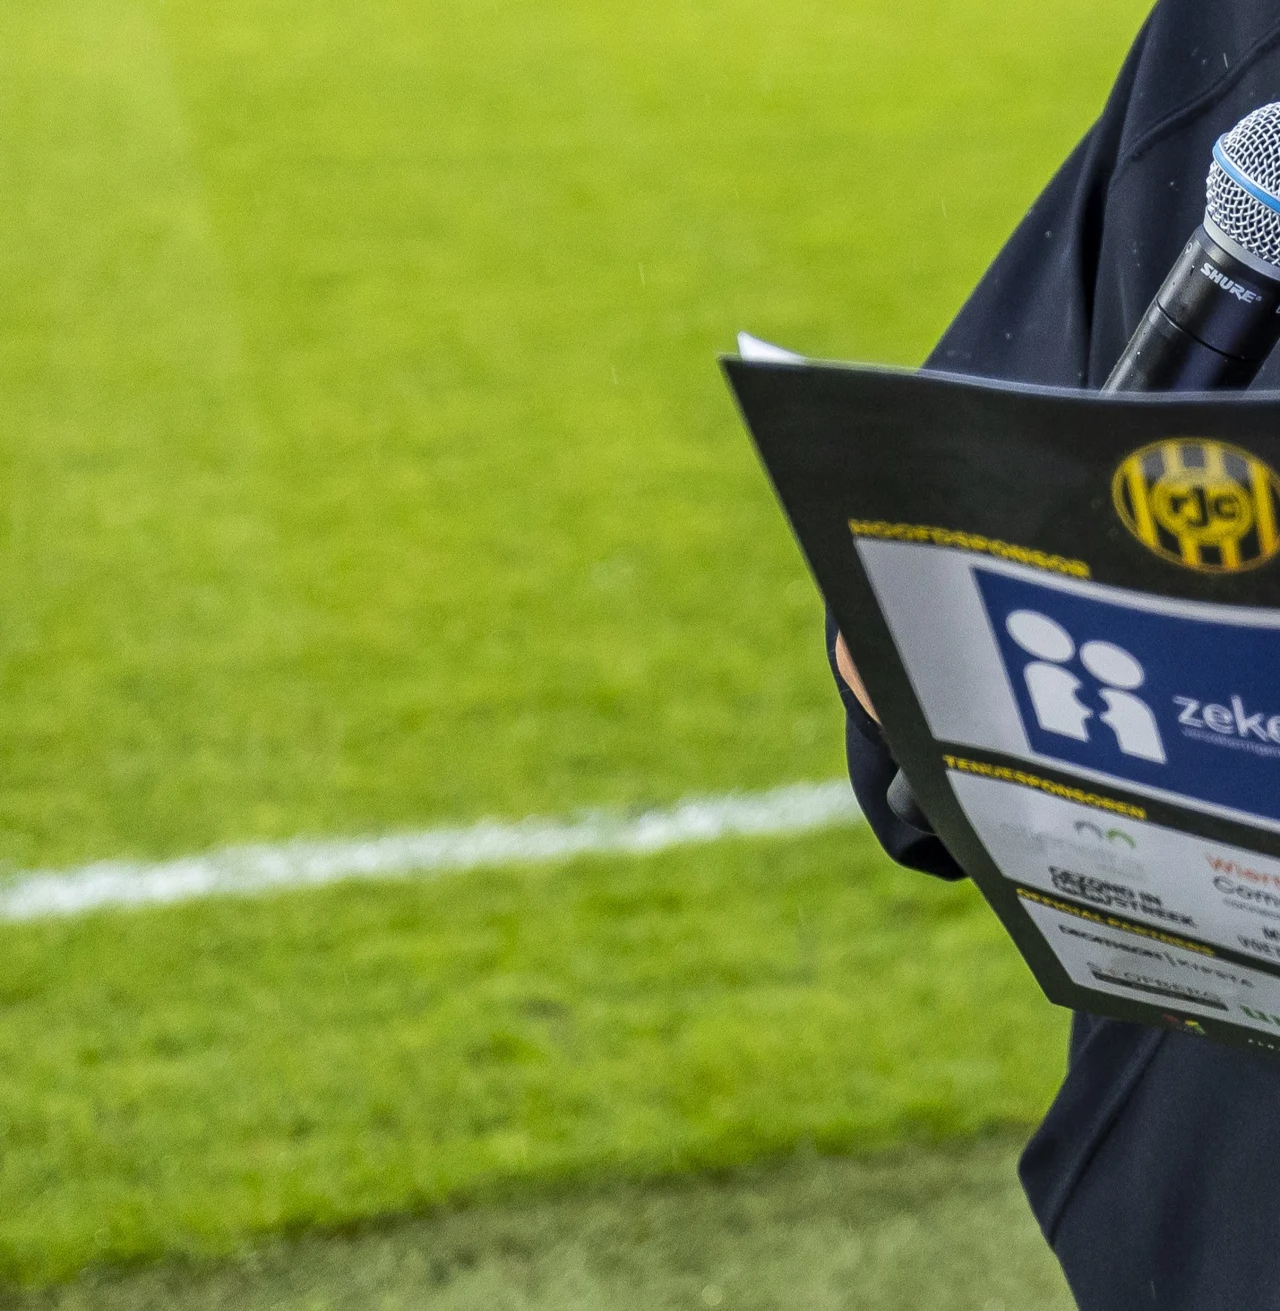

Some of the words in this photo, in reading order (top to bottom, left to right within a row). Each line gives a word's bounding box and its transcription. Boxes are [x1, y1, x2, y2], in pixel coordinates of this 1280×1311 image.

[1200, 262, 1257, 303] SHURE
[848, 518, 1092, 579] HOOFDSPONSOR
[943, 753, 1147, 821] TENUESPONSOREN
